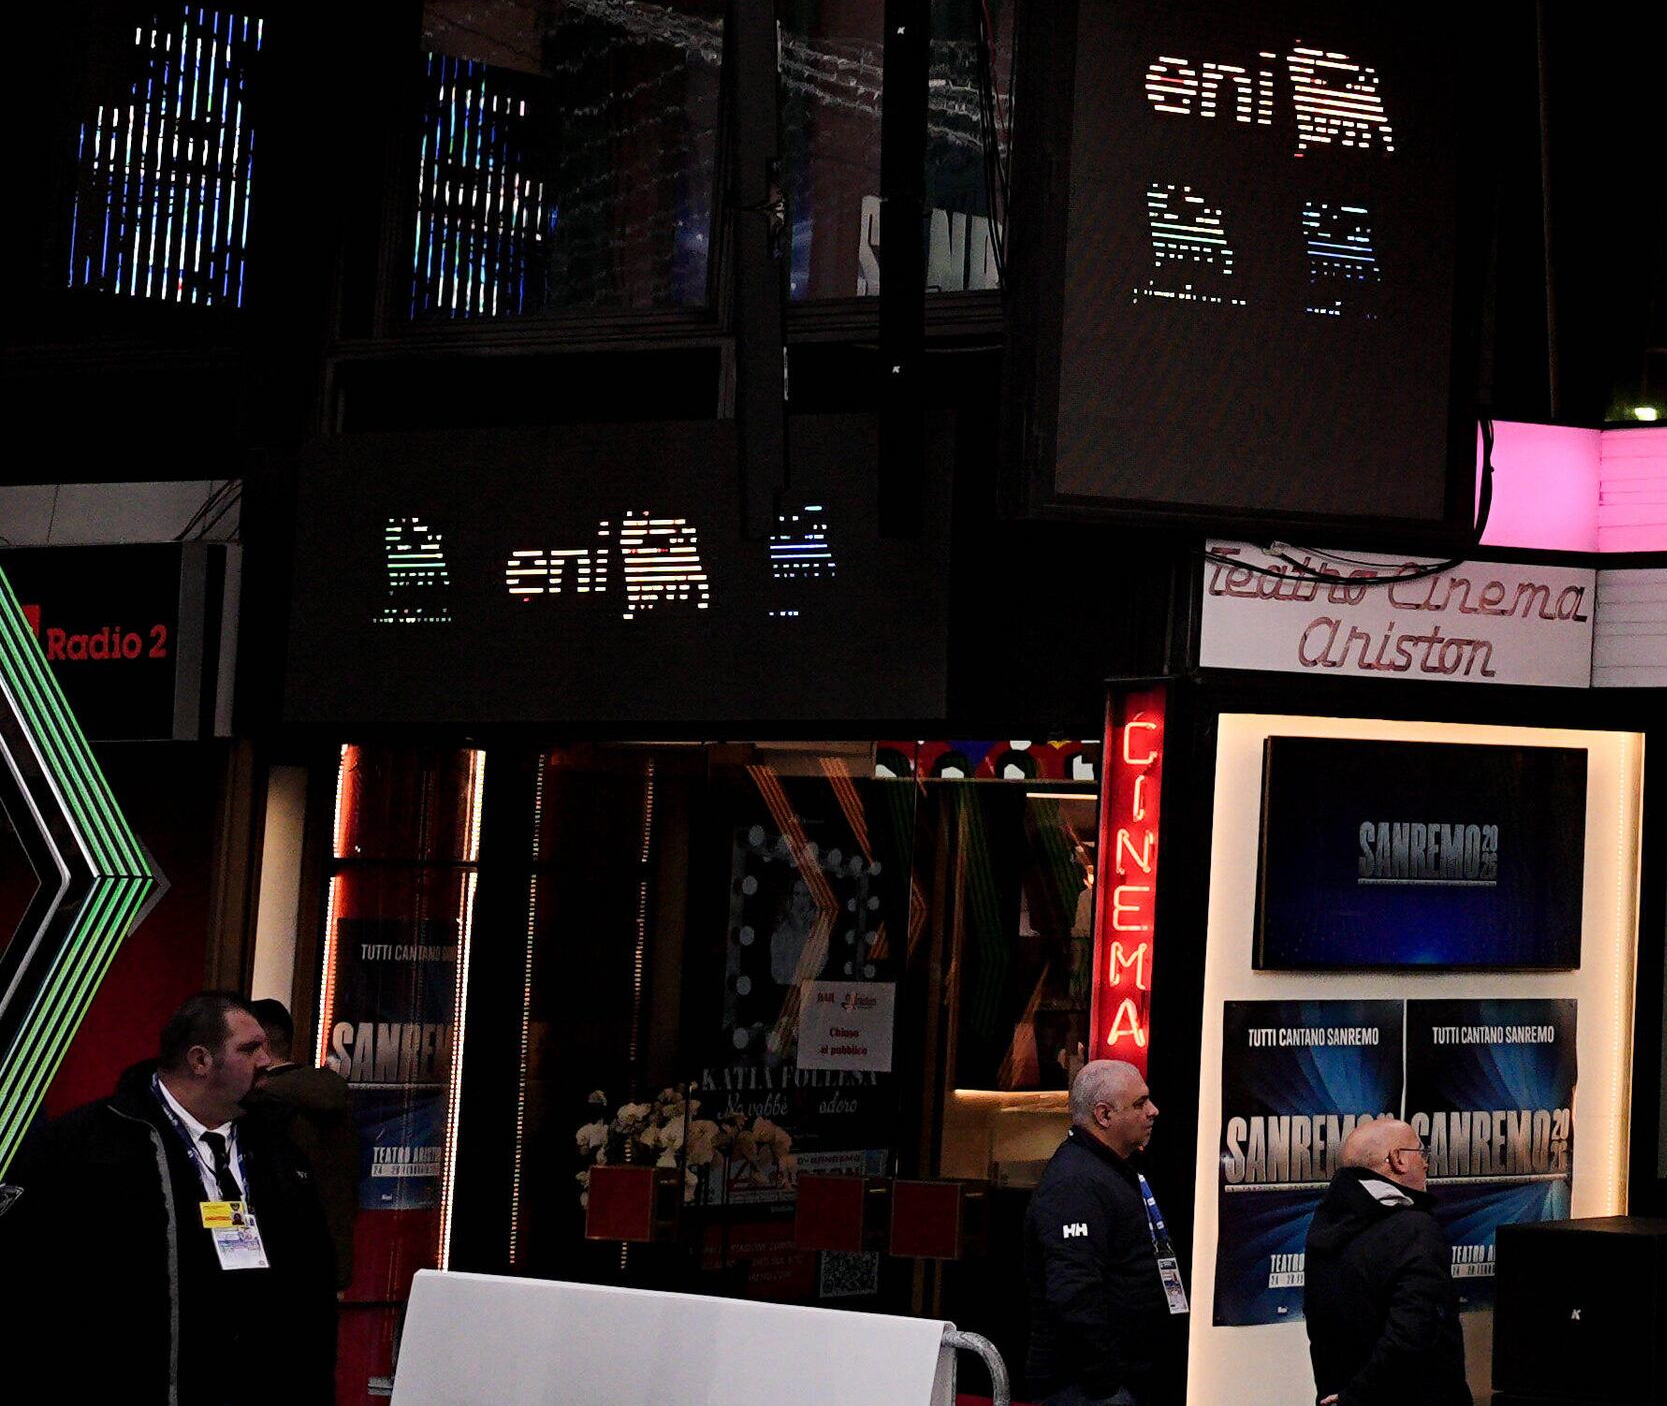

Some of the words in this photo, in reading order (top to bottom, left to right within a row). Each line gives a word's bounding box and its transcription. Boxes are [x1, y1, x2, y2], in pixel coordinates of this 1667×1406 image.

[1145, 51, 1277, 125] eni
[506, 521, 609, 602] eni
[1208, 546, 1379, 605] Teatro
[1388, 561, 1588, 623] Cinema
[46, 626, 143, 660] Radio
[149, 624, 168, 658] 2
[1298, 616, 1496, 678] Ariston
[1358, 820, 1482, 879] SANREMO
[1107, 720, 1158, 1049] CINEMA
[360, 943, 392, 961] TUTTI
[1248, 1028, 1276, 1047] TUTTI
[1279, 1027, 1325, 1046] CANTANO
[1327, 1026, 1379, 1045] SANREMO
[1432, 1025, 1459, 1044] TUTTI
[1461, 1025, 1504, 1044] CANTANO
[1505, 1025, 1554, 1043] SANREMO
[702, 1066, 774, 1091] KATIA
[1063, 1223, 1088, 1239] HH
